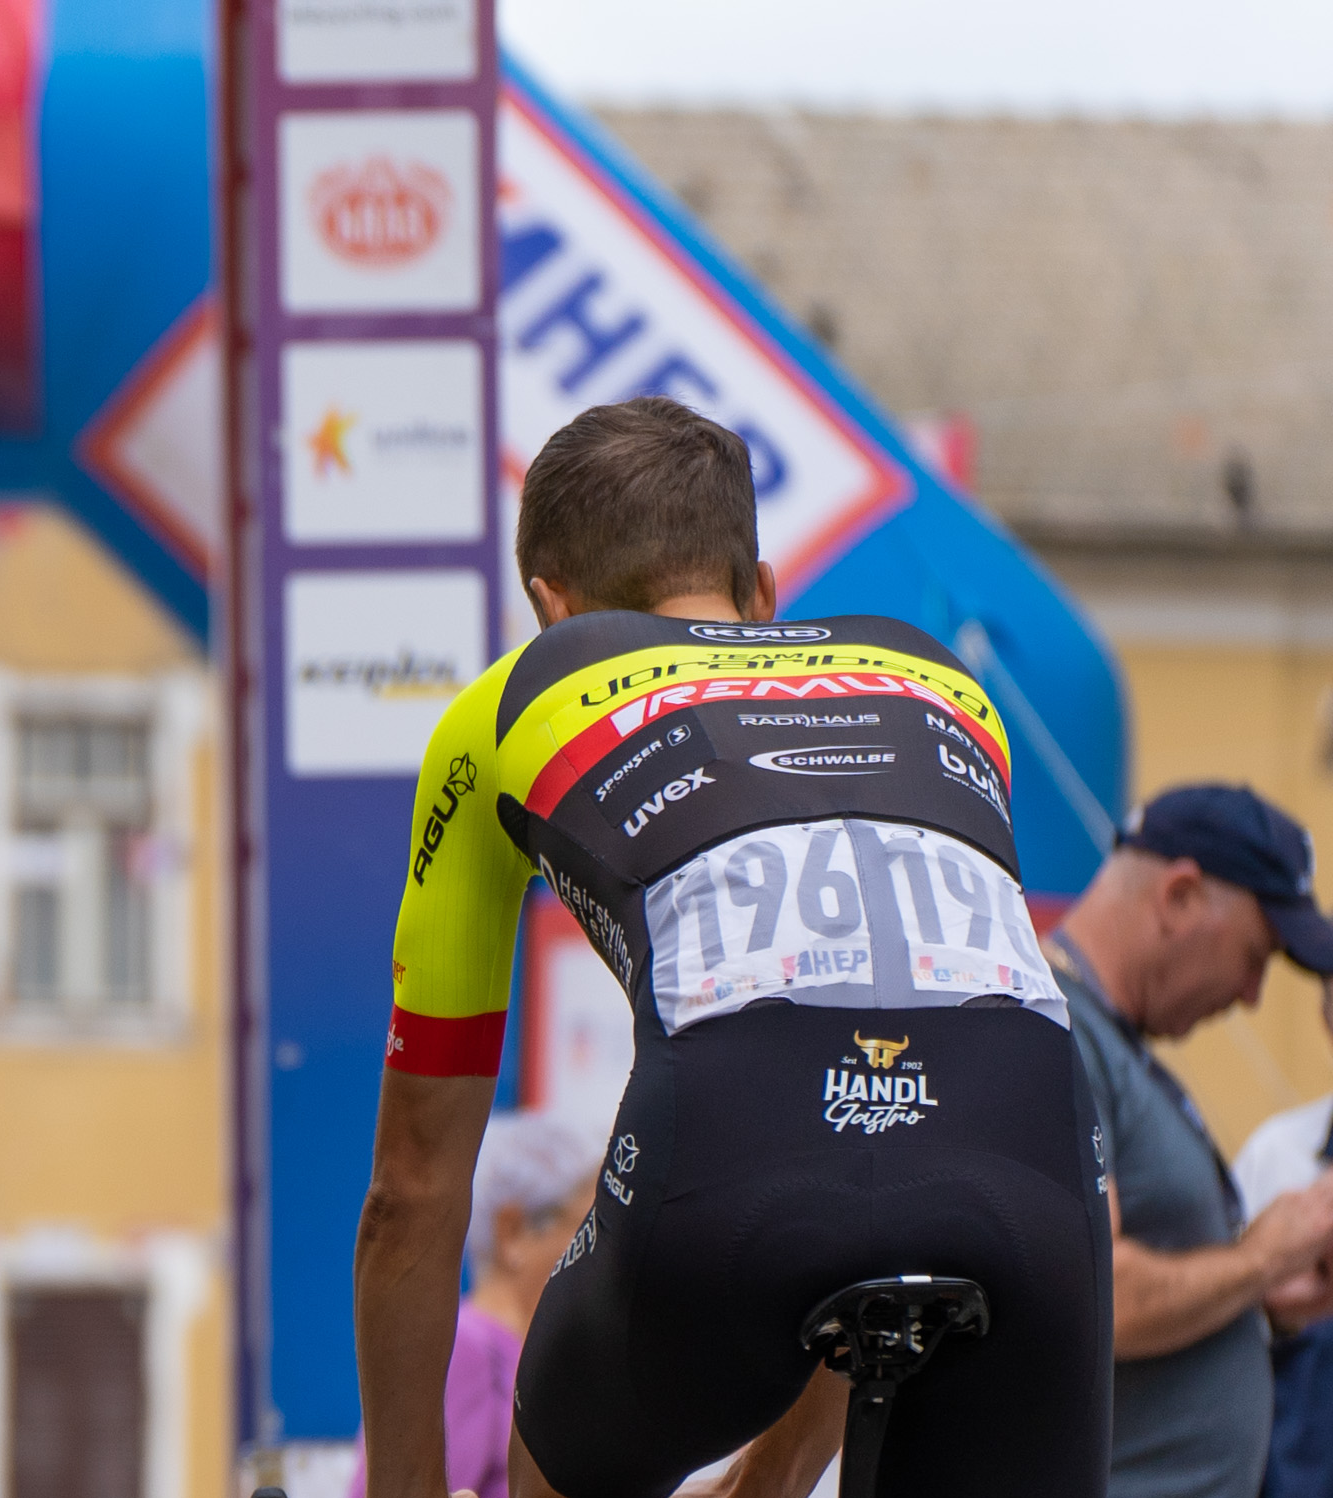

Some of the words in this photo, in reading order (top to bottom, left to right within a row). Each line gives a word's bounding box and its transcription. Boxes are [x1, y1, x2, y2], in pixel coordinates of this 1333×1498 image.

[702, 627, 821, 639] KMC
[707, 653, 803, 661] TEAM
[648, 675, 959, 718] REMUS
[595, 740, 663, 802] SPONSER
[777, 752, 896, 766] SCHWALBE
[623, 766, 717, 837] uvex
[413, 784, 459, 888] AGU
[674, 830, 862, 973] 196
[559, 871, 634, 982] Hairstyling
[823, 1067, 939, 1107] HANDL
[900, 1060, 924, 1071] 1902
[824, 1091, 926, 1135] Gastro
[603, 1168, 634, 1206] AGU
